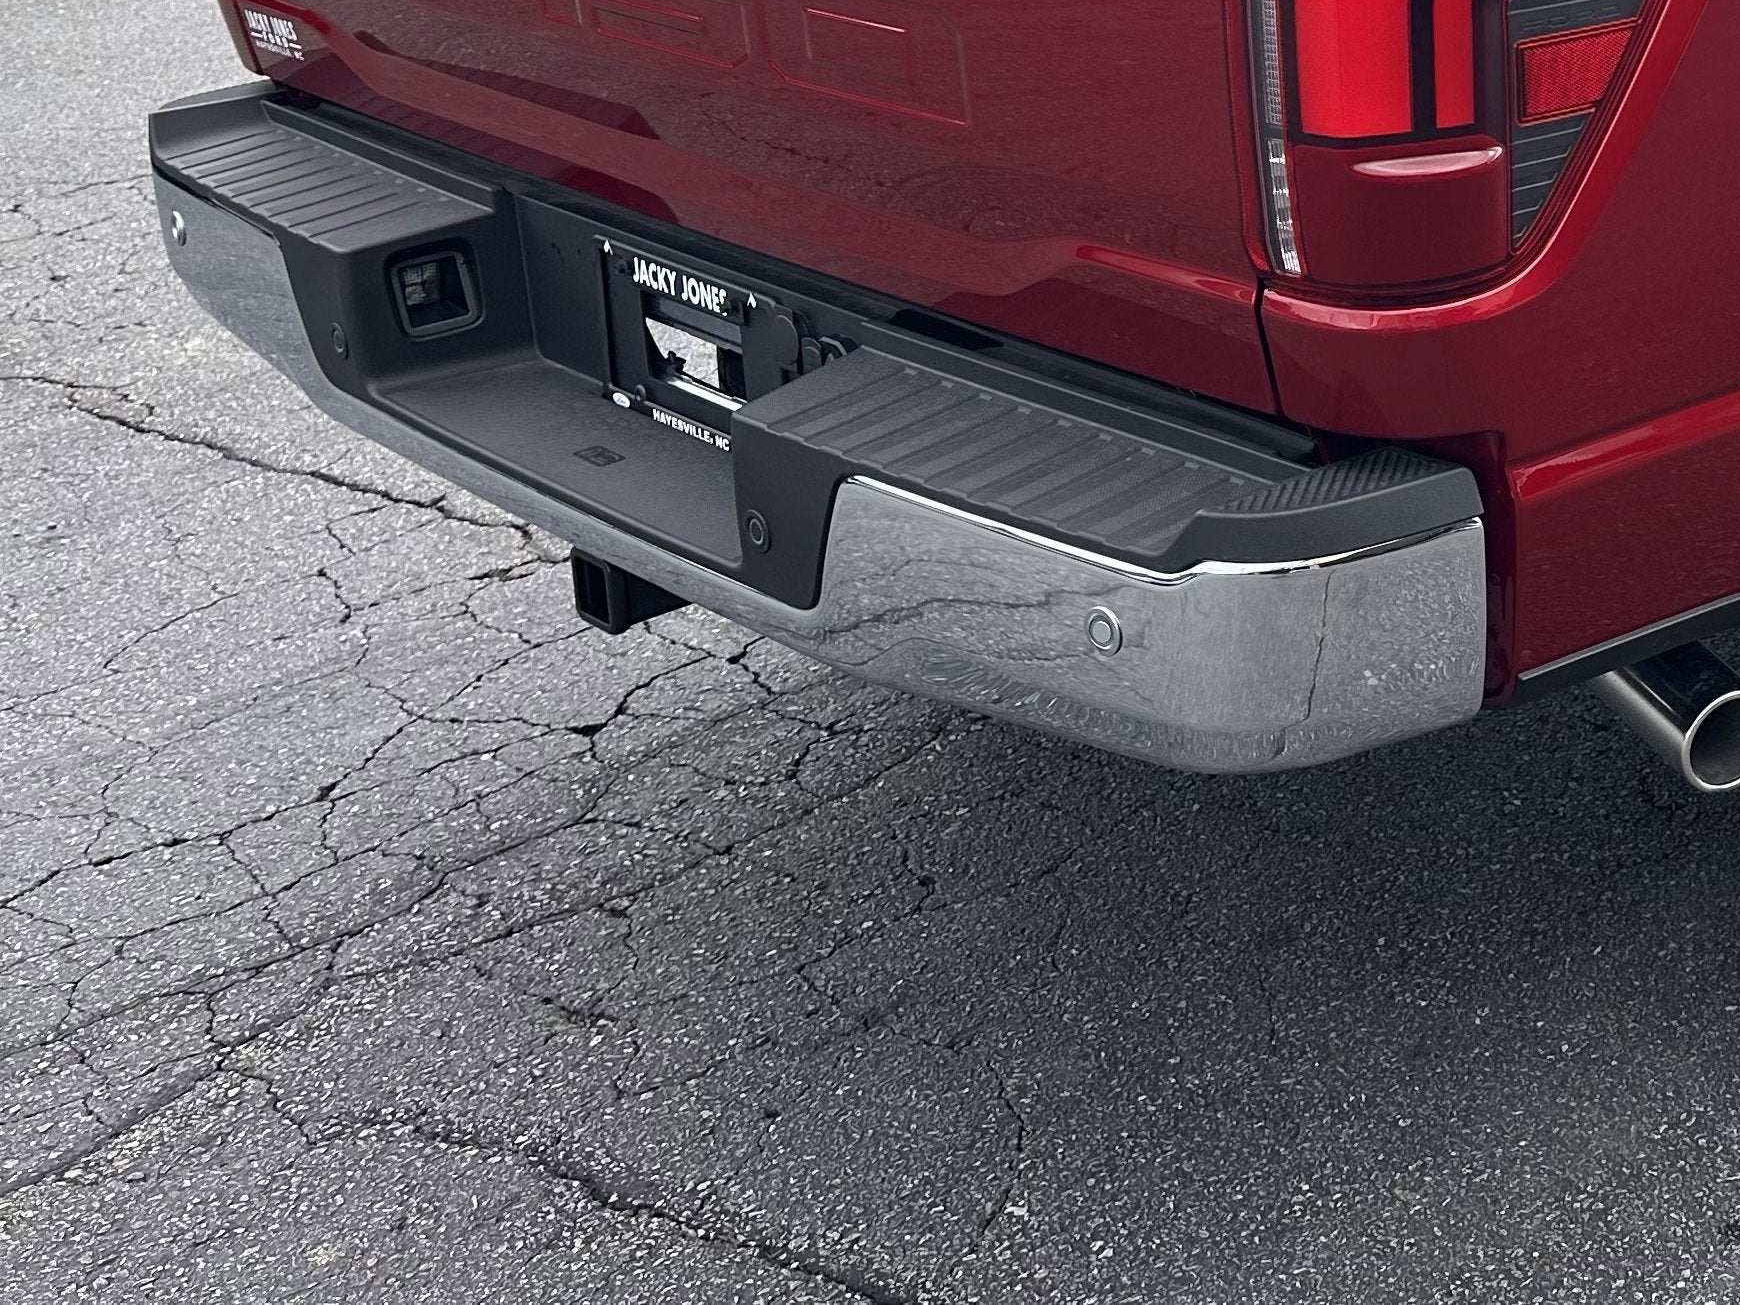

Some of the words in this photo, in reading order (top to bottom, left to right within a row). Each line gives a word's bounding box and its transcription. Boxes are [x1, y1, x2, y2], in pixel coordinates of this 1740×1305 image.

[244, 9, 271, 32] JACKY
[270, 16, 298, 41] JONES
[632, 256, 678, 296] JACKY
[681, 274, 729, 317] JONES
[652, 408, 714, 445] HAYESVILLE,
[715, 435, 730, 452] NC
